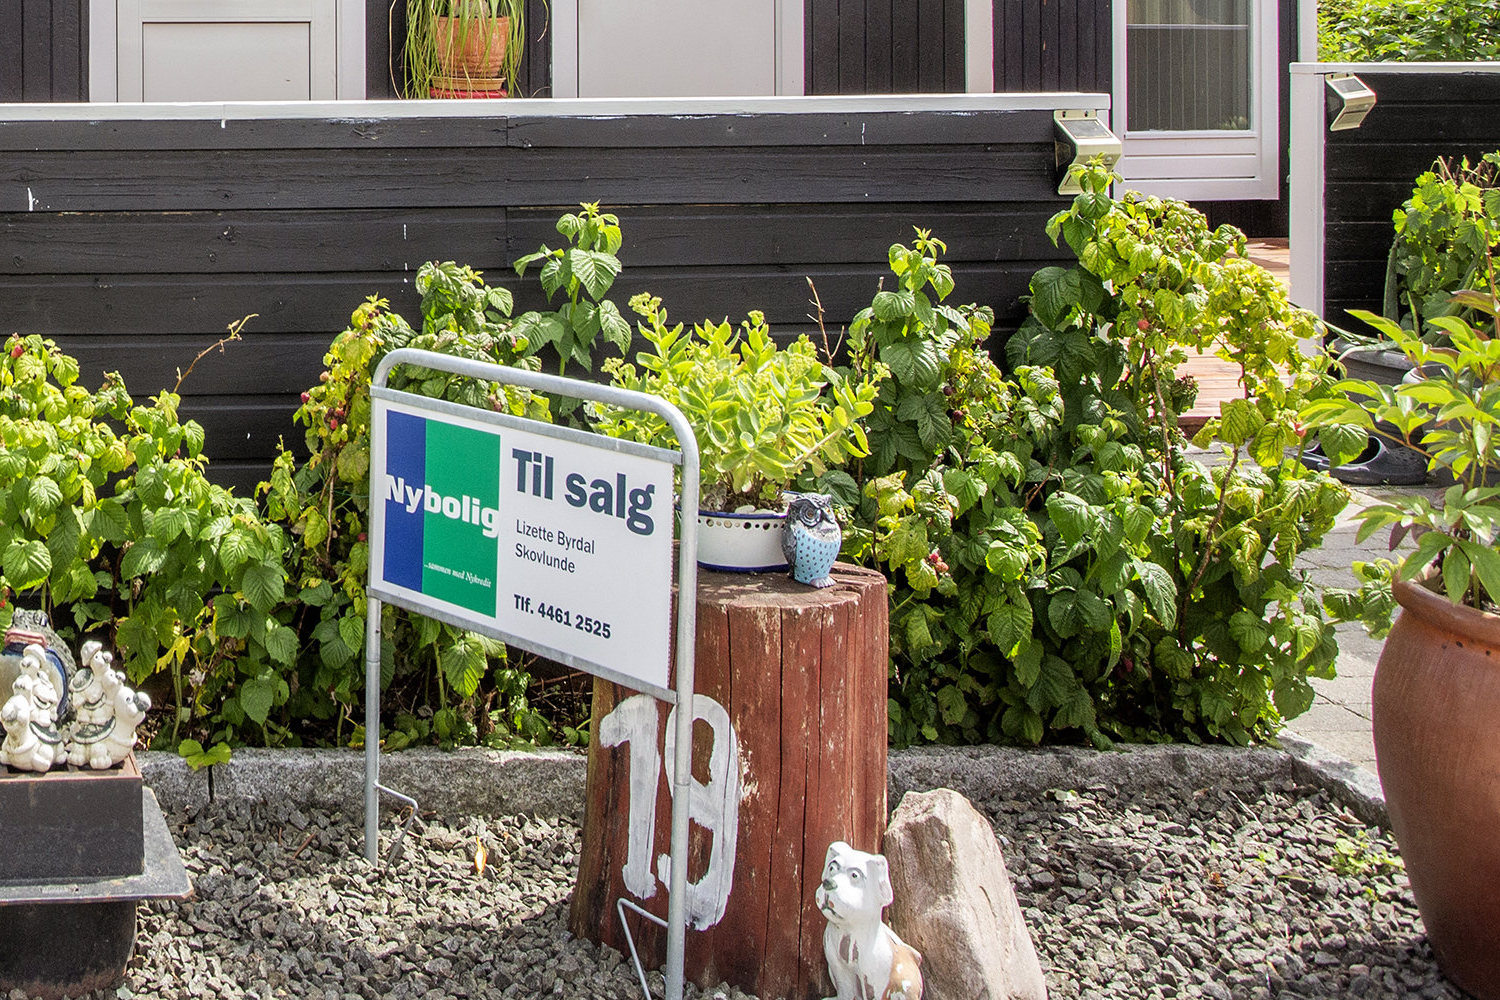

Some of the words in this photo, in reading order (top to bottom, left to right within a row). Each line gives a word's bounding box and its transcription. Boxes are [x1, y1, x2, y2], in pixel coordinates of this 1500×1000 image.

[385, 473, 500, 539] Nybolig
[512, 448, 554, 501] Til
[564, 472, 656, 536] salg
[515, 542, 576, 573] Skovlunde
[516, 518, 554, 543] Lizette
[557, 530, 595, 555] Byrdal
[451, 569, 466, 580] med
[513, 593, 534, 615] Tlf.
[537, 602, 572, 627] 4461
[575, 614, 611, 639] 2525
[599, 693, 739, 931] 19
